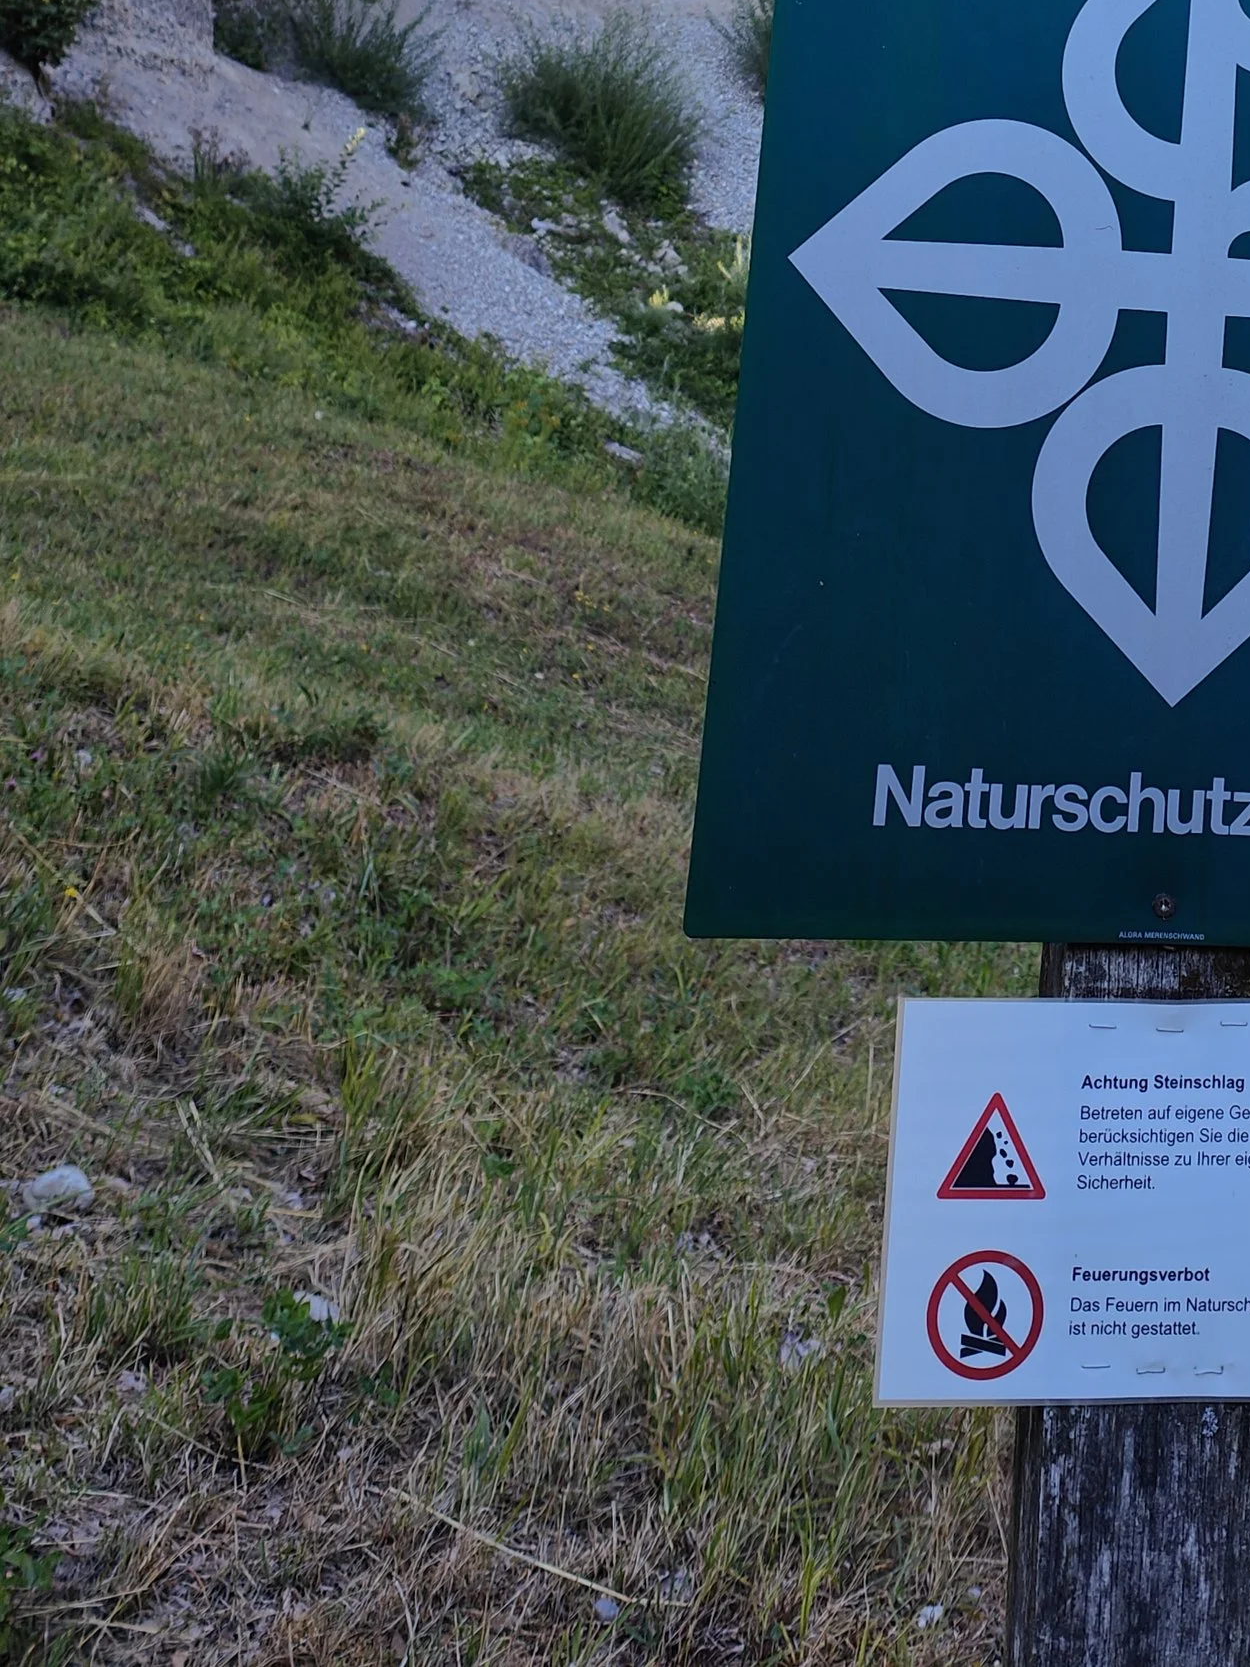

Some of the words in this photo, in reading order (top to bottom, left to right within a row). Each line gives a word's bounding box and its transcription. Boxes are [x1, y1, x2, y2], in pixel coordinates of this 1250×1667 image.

[1081, 1075, 1149, 1093] Achtung
[1153, 1075, 1245, 1093] Steinschlag
[1080, 1105, 1143, 1121] Betreten
[1148, 1105, 1171, 1121] auf
[1174, 1105, 1224, 1123] eigene
[1079, 1128, 1194, 1146] berücksichtigen
[1199, 1128, 1223, 1144] Sie
[1227, 1128, 1249, 1144] die
[1078, 1151, 1170, 1167] Verhältnisse
[1174, 1154, 1193, 1167] zu
[1197, 1150, 1230, 1167] Ihrer
[1077, 1174, 1155, 1190] Sicherheit.
[1072, 1268, 1210, 1285] Feuerungsverbot
[1070, 1296, 1101, 1313] Das
[1105, 1296, 1159, 1313] Feuern
[1163, 1296, 1181, 1313] im
[1069, 1320, 1086, 1336] ist
[1091, 1319, 1128, 1336] nicht
[1132, 1320, 1200, 1339] gestattet.
